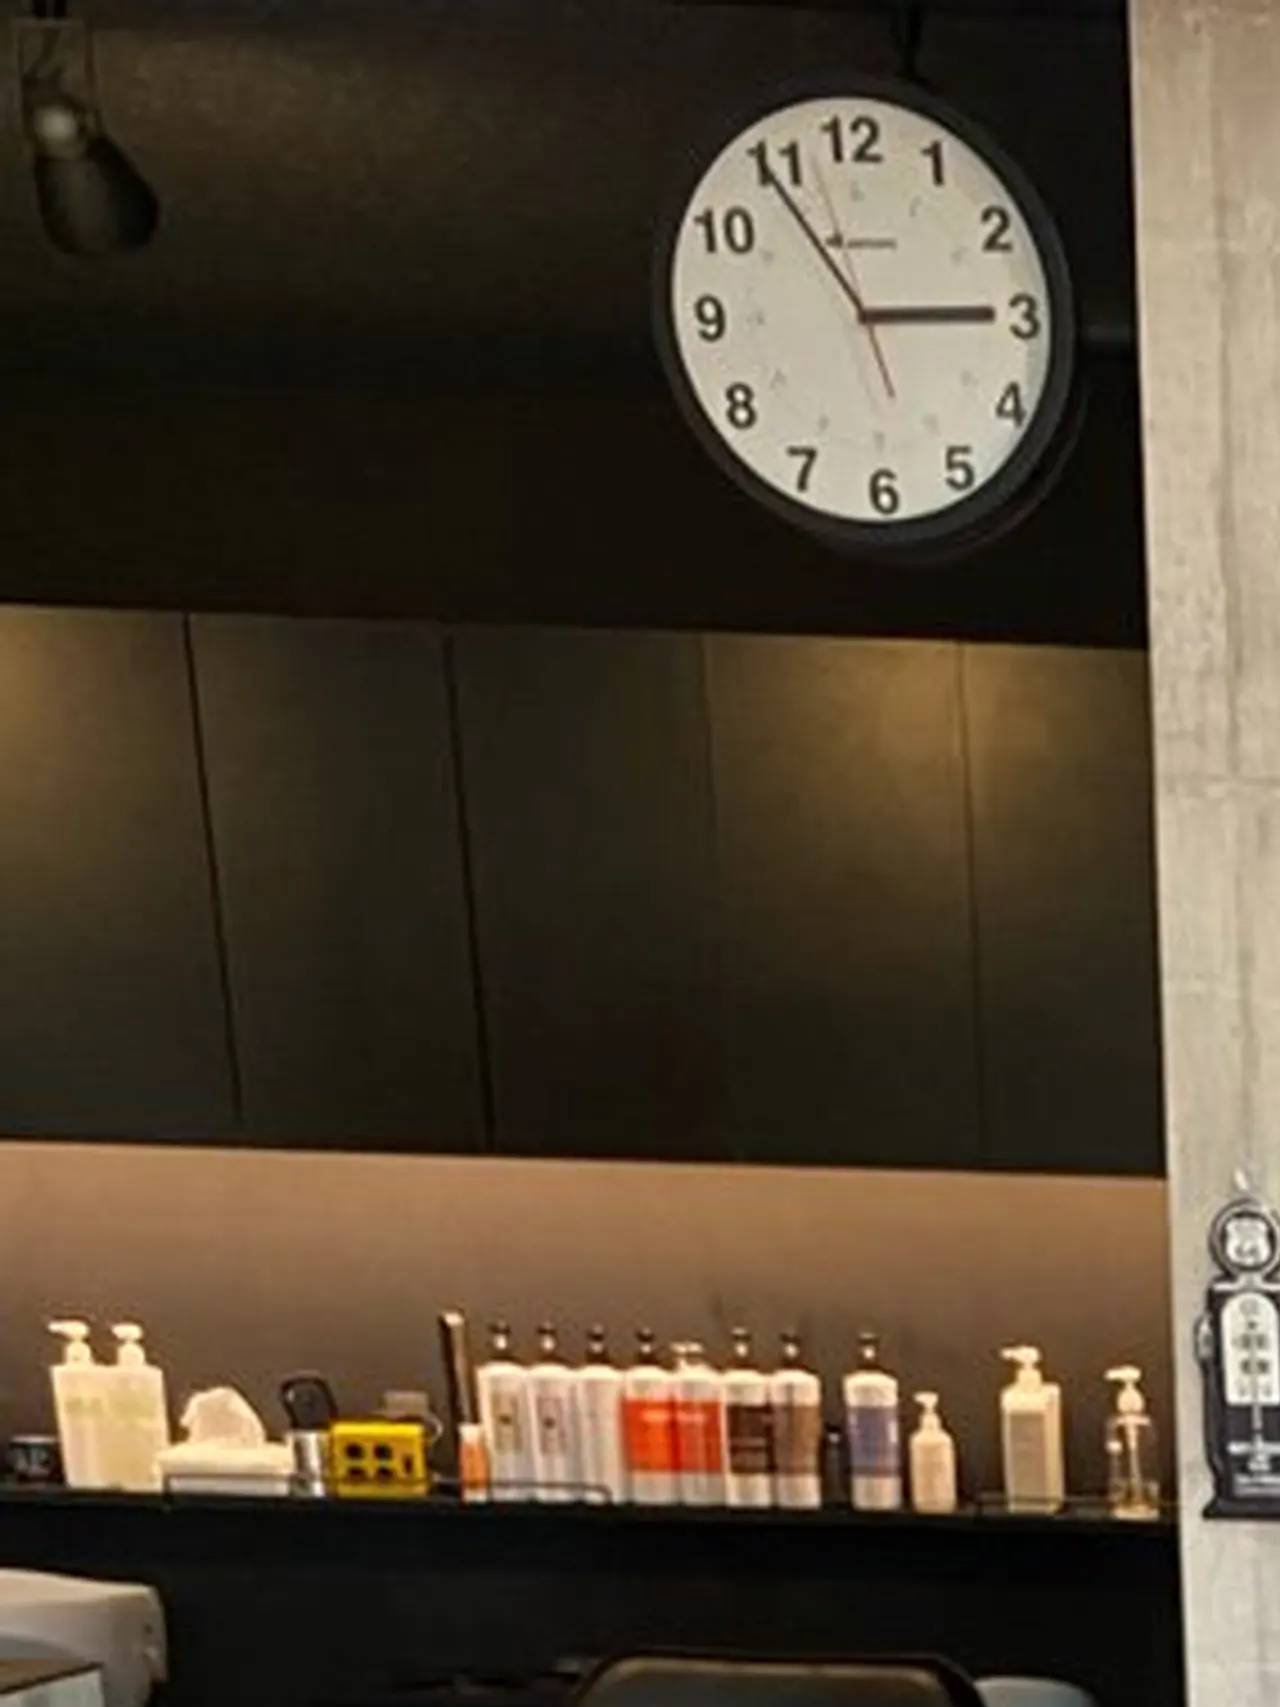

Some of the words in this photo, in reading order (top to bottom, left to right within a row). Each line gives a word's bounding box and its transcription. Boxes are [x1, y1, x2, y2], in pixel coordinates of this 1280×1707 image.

[821, 115, 883, 164] 12
[748, 140, 803, 186] 11
[921, 140, 946, 186] 1
[694, 205, 754, 254] 10
[981, 205, 1011, 252] 2
[693, 295, 725, 342] 9
[1008, 295, 1040, 340] 3
[725, 383, 757, 429] 8
[996, 382, 1027, 427] 4
[787, 447, 818, 492] 7
[944, 445, 974, 490] 5
[870, 469, 900, 514] 6
